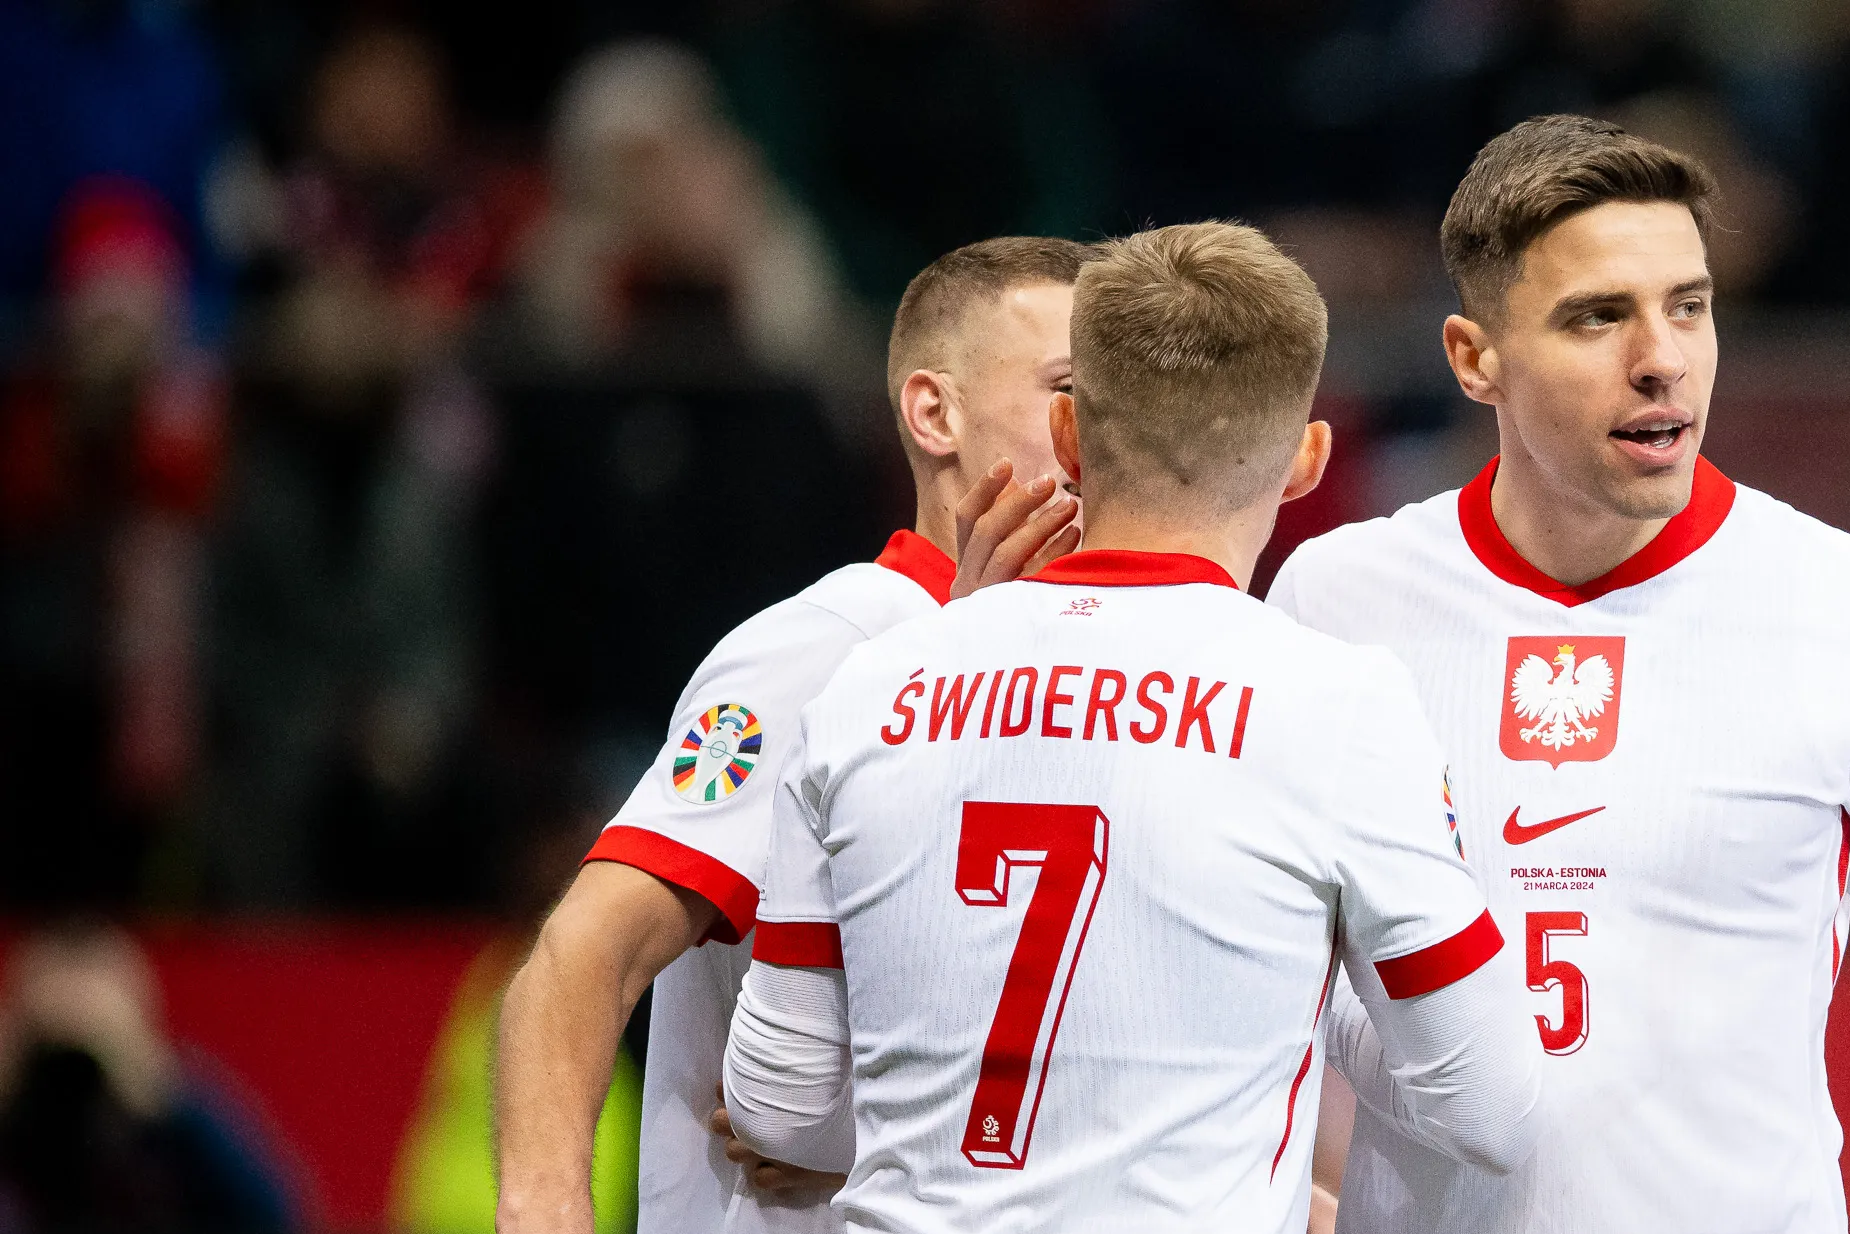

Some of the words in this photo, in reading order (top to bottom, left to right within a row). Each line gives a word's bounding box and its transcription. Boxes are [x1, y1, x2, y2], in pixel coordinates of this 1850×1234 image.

[880, 665, 1254, 760] ŚWIDERSKI
[1523, 882, 1533, 891] 21
[1535, 882, 1569, 891] MARCA
[1570, 881, 1594, 890] 2024
[954, 800, 1111, 1171] 7
[1525, 910, 1590, 1057] 5
